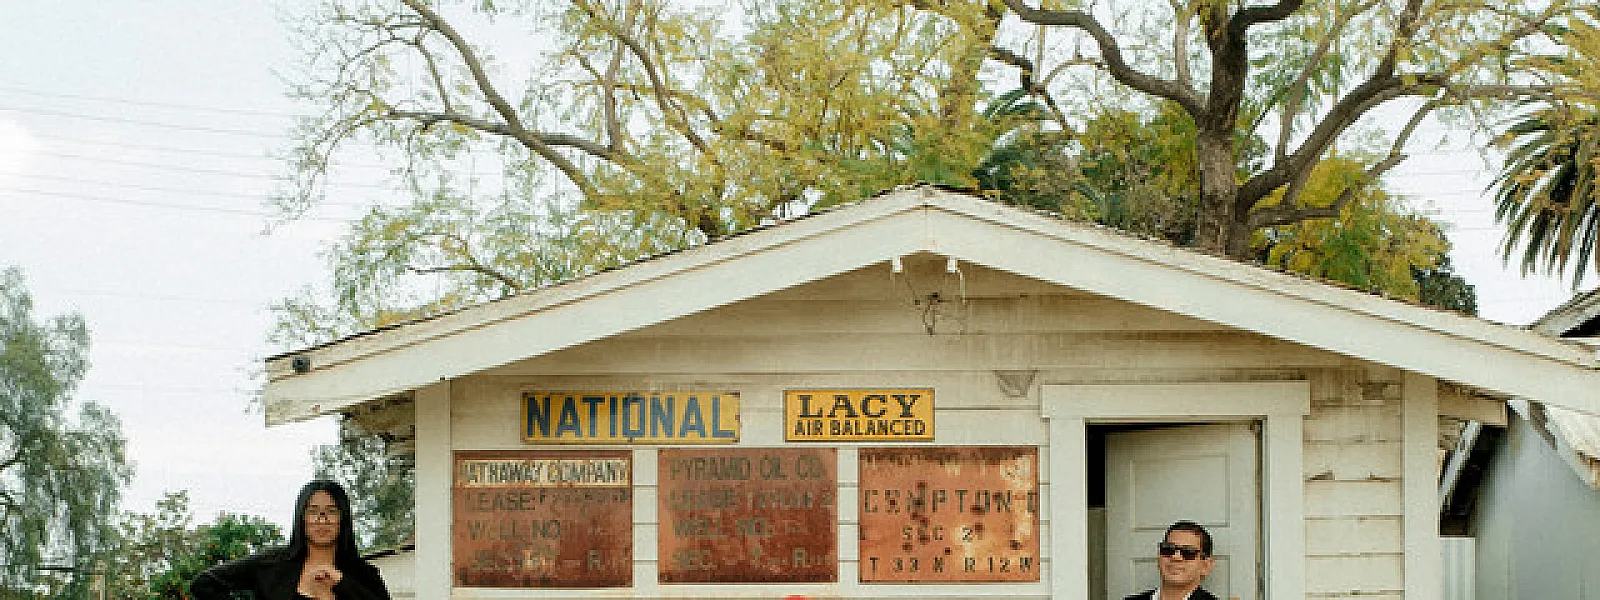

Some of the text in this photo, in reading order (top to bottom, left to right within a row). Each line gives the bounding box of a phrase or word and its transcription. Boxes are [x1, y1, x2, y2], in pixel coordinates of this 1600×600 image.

[525, 394, 736, 439] NATIONAL
[797, 394, 922, 418] LACY
[794, 419, 926, 436] AIR BALANCED
[548, 462, 627, 483] COMPANY
[669, 456, 751, 481] PYRAMID
[758, 454, 789, 481] OIL
